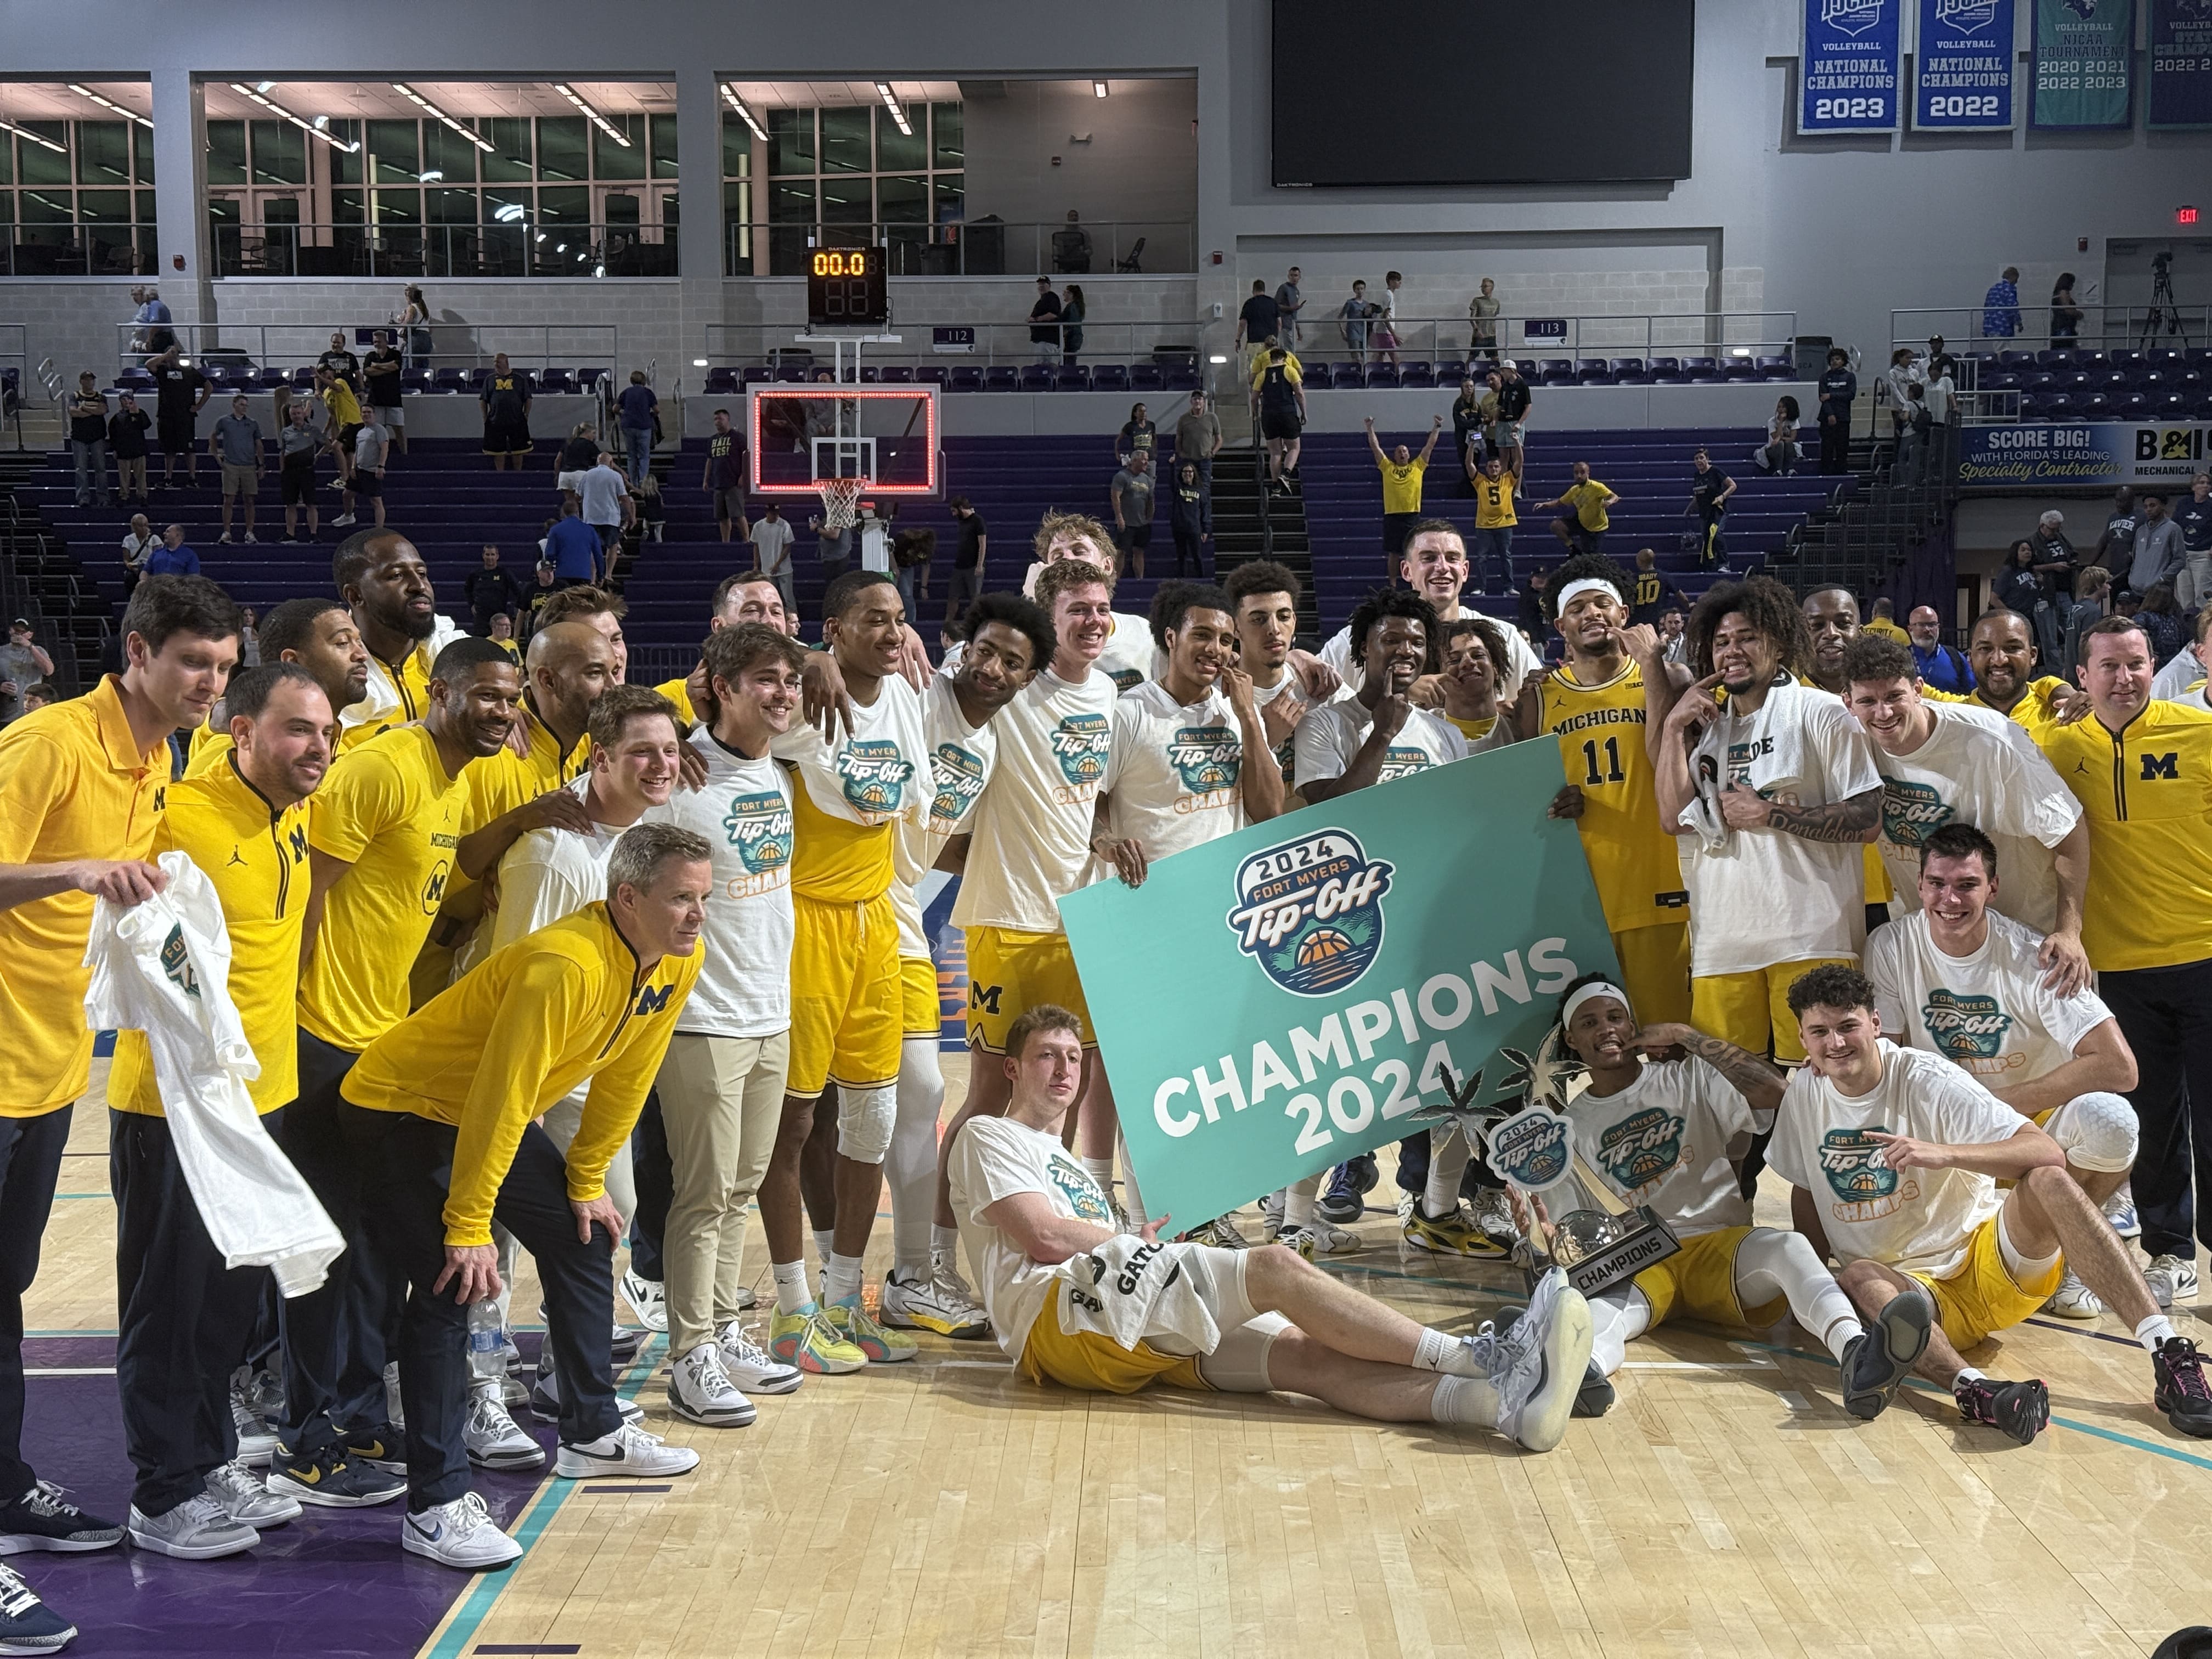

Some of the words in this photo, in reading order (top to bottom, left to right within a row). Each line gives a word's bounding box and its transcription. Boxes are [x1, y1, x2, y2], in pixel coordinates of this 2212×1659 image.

[2055, 23, 2113, 31] VOLLEYBALL
[1822, 42, 1881, 50] VOLLEYBALL
[1937, 40, 1996, 48] VOLLEYBALL
[2063, 34, 2103, 45] NJCAA
[2040, 46, 2126, 58] TOURNAMENT
[1814, 59, 1888, 74] NATIONAL
[1928, 57, 2002, 72] NATIONAL
[2039, 61, 2079, 74] 2020
[2085, 60, 2125, 72] 2021
[2154, 59, 2195, 72] 2022
[1808, 75, 1894, 89] CHAMPIONS
[1921, 73, 2008, 87] CHAMPIONS
[2038, 77, 2079, 89] 2022
[2085, 77, 2126, 88] 2023
[1816, 98, 1884, 119] 2023
[1930, 96, 1999, 117] 2022
[2180, 209, 2197, 223] EXIT
[814, 253, 865, 276] 00.0
[948, 331, 967, 341] 112
[1541, 323, 1559, 334] 113
[495, 379, 513, 390] M
[712, 437, 731, 448] HAIL
[1988, 430, 2047, 449] SCORE
[2054, 430, 2090, 447] BIG!
[1971, 453, 2000, 463] WITH
[2004, 450, 2059, 461] FLORIDA'S
[2063, 450, 2110, 461] LEADING
[1959, 461, 2034, 482] Specialty
[2035, 460, 2122, 477] Contractor
[2135, 466, 2196, 476] MECHANICAL
[1488, 486, 1501, 505] 5
[2109, 519, 2135, 532] XAVIER
[2050, 546, 2065, 557] 32
[1637, 580, 1660, 605] 10
[1085, 720, 1107, 729] MYERS
[1551, 708, 1646, 736] MICHIGAN
[868, 747, 896, 756] MYERS
[941, 748, 962, 763] FORT
[1583, 736, 1624, 786] 11
[839, 754, 909, 783] Tip-Off
[2141, 752, 2177, 780] M
[153, 786, 165, 812] M
[1901, 788, 1935, 799] MYERS
[736, 801, 760, 811] FORT
[764, 798, 783, 808] MYERS
[1769, 812, 1865, 842] Donaldson
[289, 823, 308, 865] M
[1256, 839, 1334, 882] 2024
[426, 873, 445, 901] M
[1254, 879, 1291, 902] FORT
[1296, 860, 1350, 887] MYERS
[1233, 866, 1383, 947] Tip-Off
[634, 985, 674, 1015] M
[972, 980, 1003, 1015] M
[1957, 1001, 1993, 1009] MYERS
[1925, 1007, 2006, 1035] Tip-Off
[1153, 937, 1578, 1138] CHAMPIONS
[1284, 1040, 1465, 1156] 2024
[1504, 1118, 1537, 1141] 2024
[1604, 1126, 1627, 1143] FORT
[1629, 1111, 1662, 1128] MYERS
[1496, 1124, 1562, 1170] Tip-Off
[1504, 1138, 1522, 1151] FORT
[1523, 1125, 1546, 1140] MYERS
[1829, 1136, 1854, 1144] FORT
[1832, 1180, 1920, 1223] CHAMPS
[1577, 1237, 1662, 1290] CHAMPIONS
